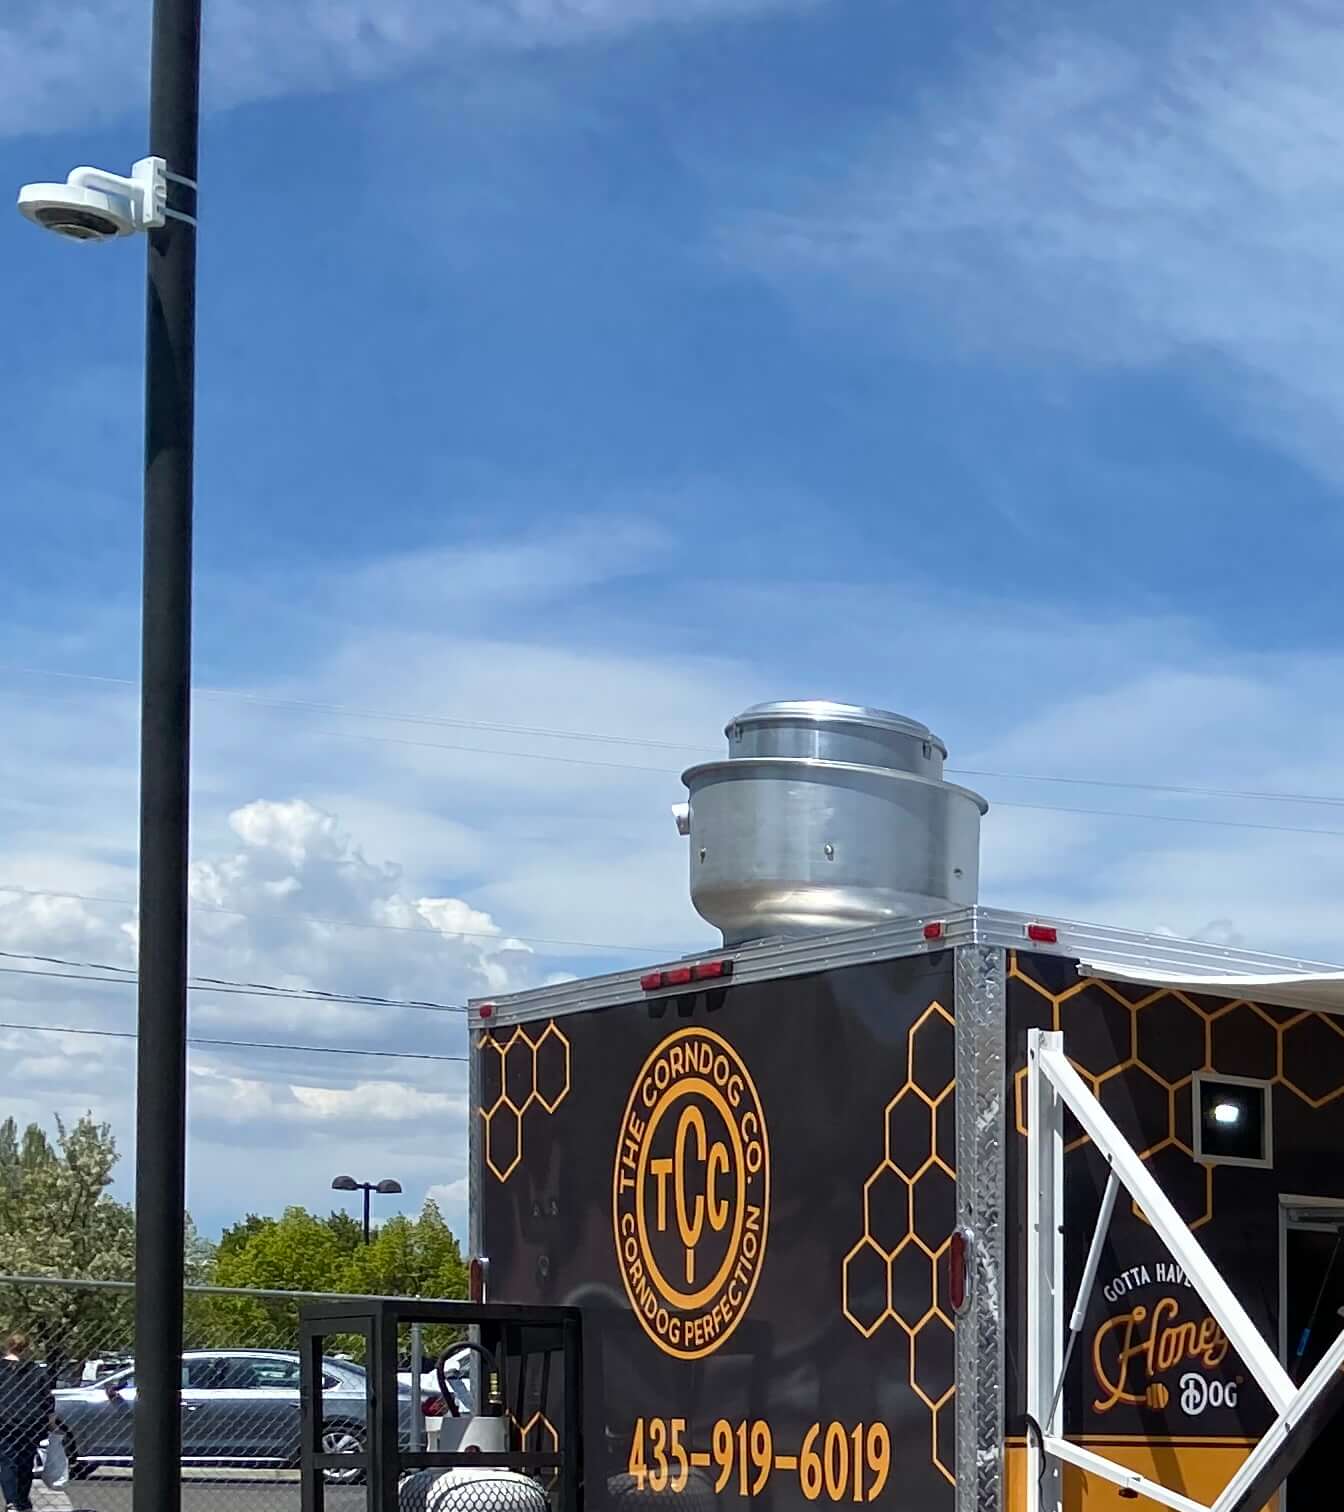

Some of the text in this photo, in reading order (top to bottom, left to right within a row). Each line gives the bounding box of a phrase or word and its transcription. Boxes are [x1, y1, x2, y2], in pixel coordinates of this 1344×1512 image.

[620, 1111, 645, 1194] THE
[641, 1041, 743, 1108] CORNDOG
[621, 1205, 761, 1347] CORNDOG PERFECTION
[1104, 1265, 1151, 1302] GOTTA
[628, 1417, 892, 1502] 435-919-6019
